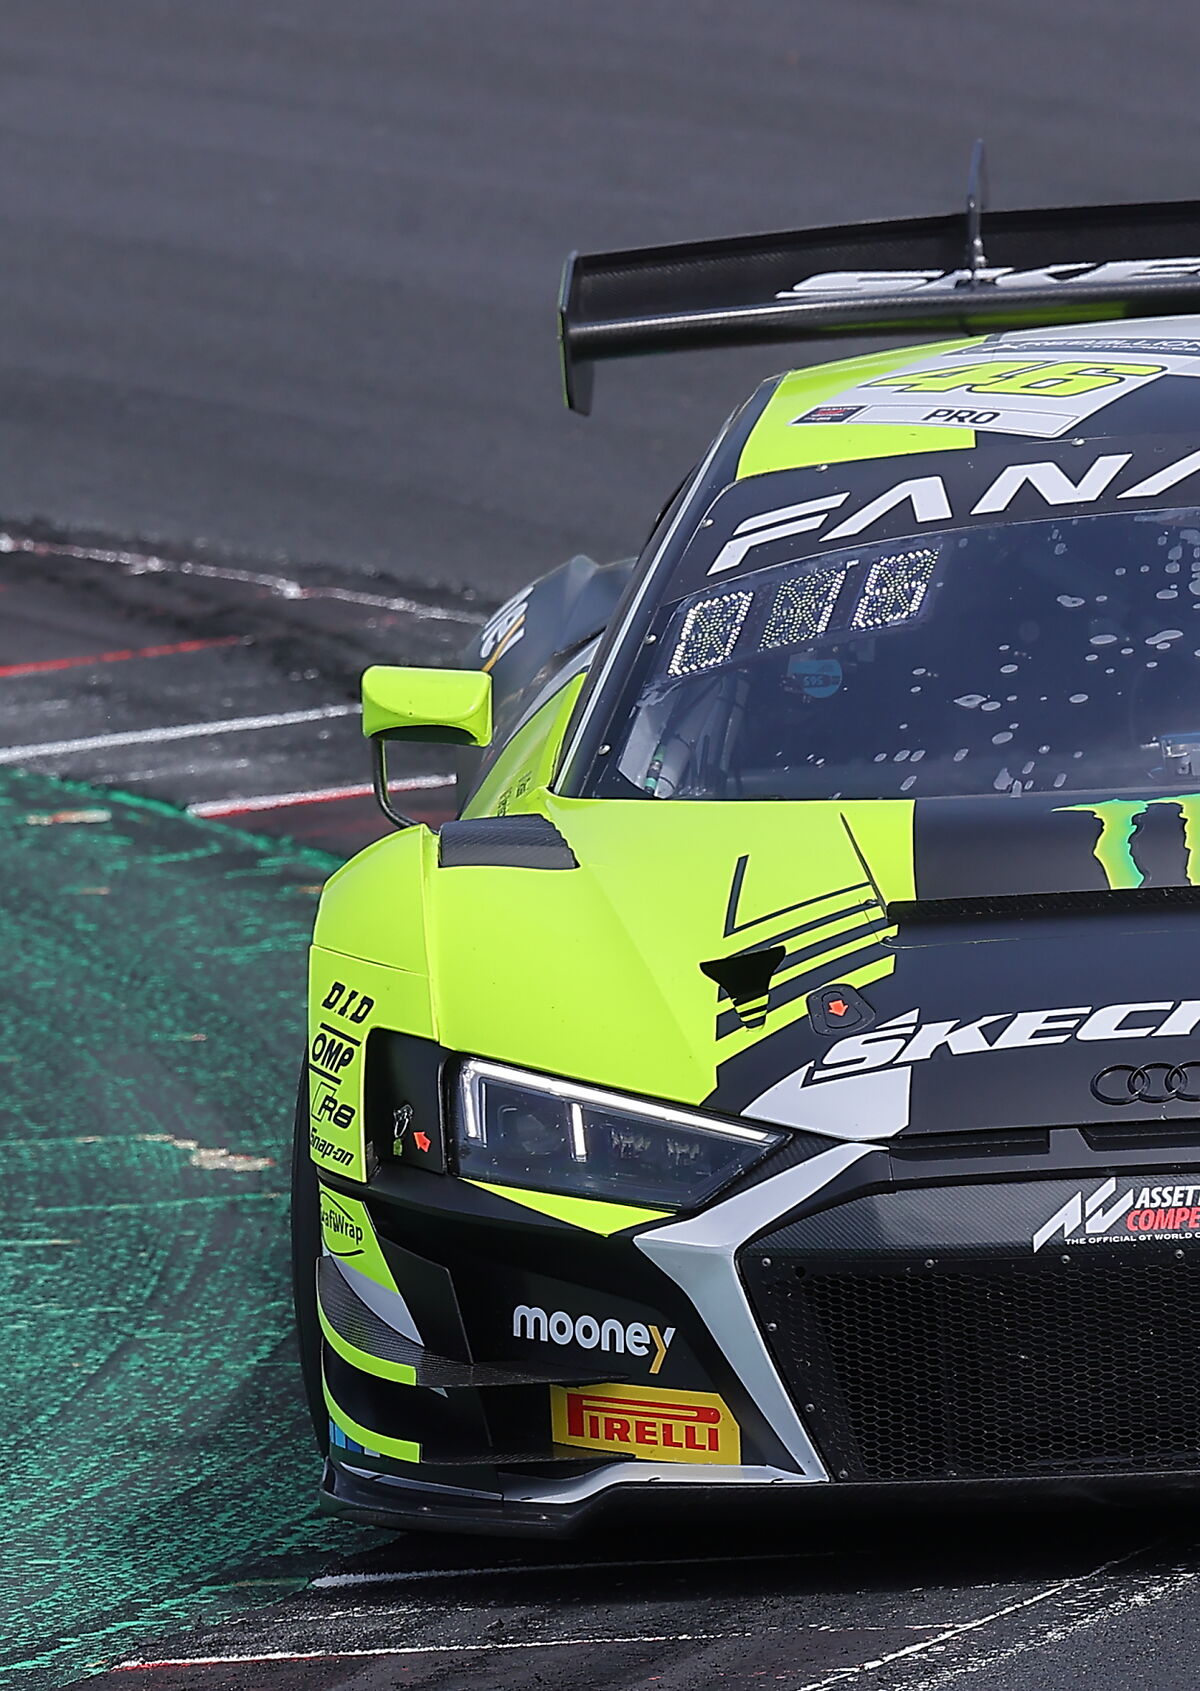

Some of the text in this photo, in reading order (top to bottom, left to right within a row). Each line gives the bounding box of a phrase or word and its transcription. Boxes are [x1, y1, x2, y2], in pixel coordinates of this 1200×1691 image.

[857, 360, 1168, 398] 46
[922, 408, 1001, 425] PRO
[312, 1032, 355, 1074] OMP
[317, 1094, 356, 1129] R8
[1088, 1235, 1136, 1244] OFFICIAL
[1154, 1232, 1192, 1240] WORLD
[513, 1304, 676, 1374] mooney
[567, 1392, 722, 1453] PIRELLI
